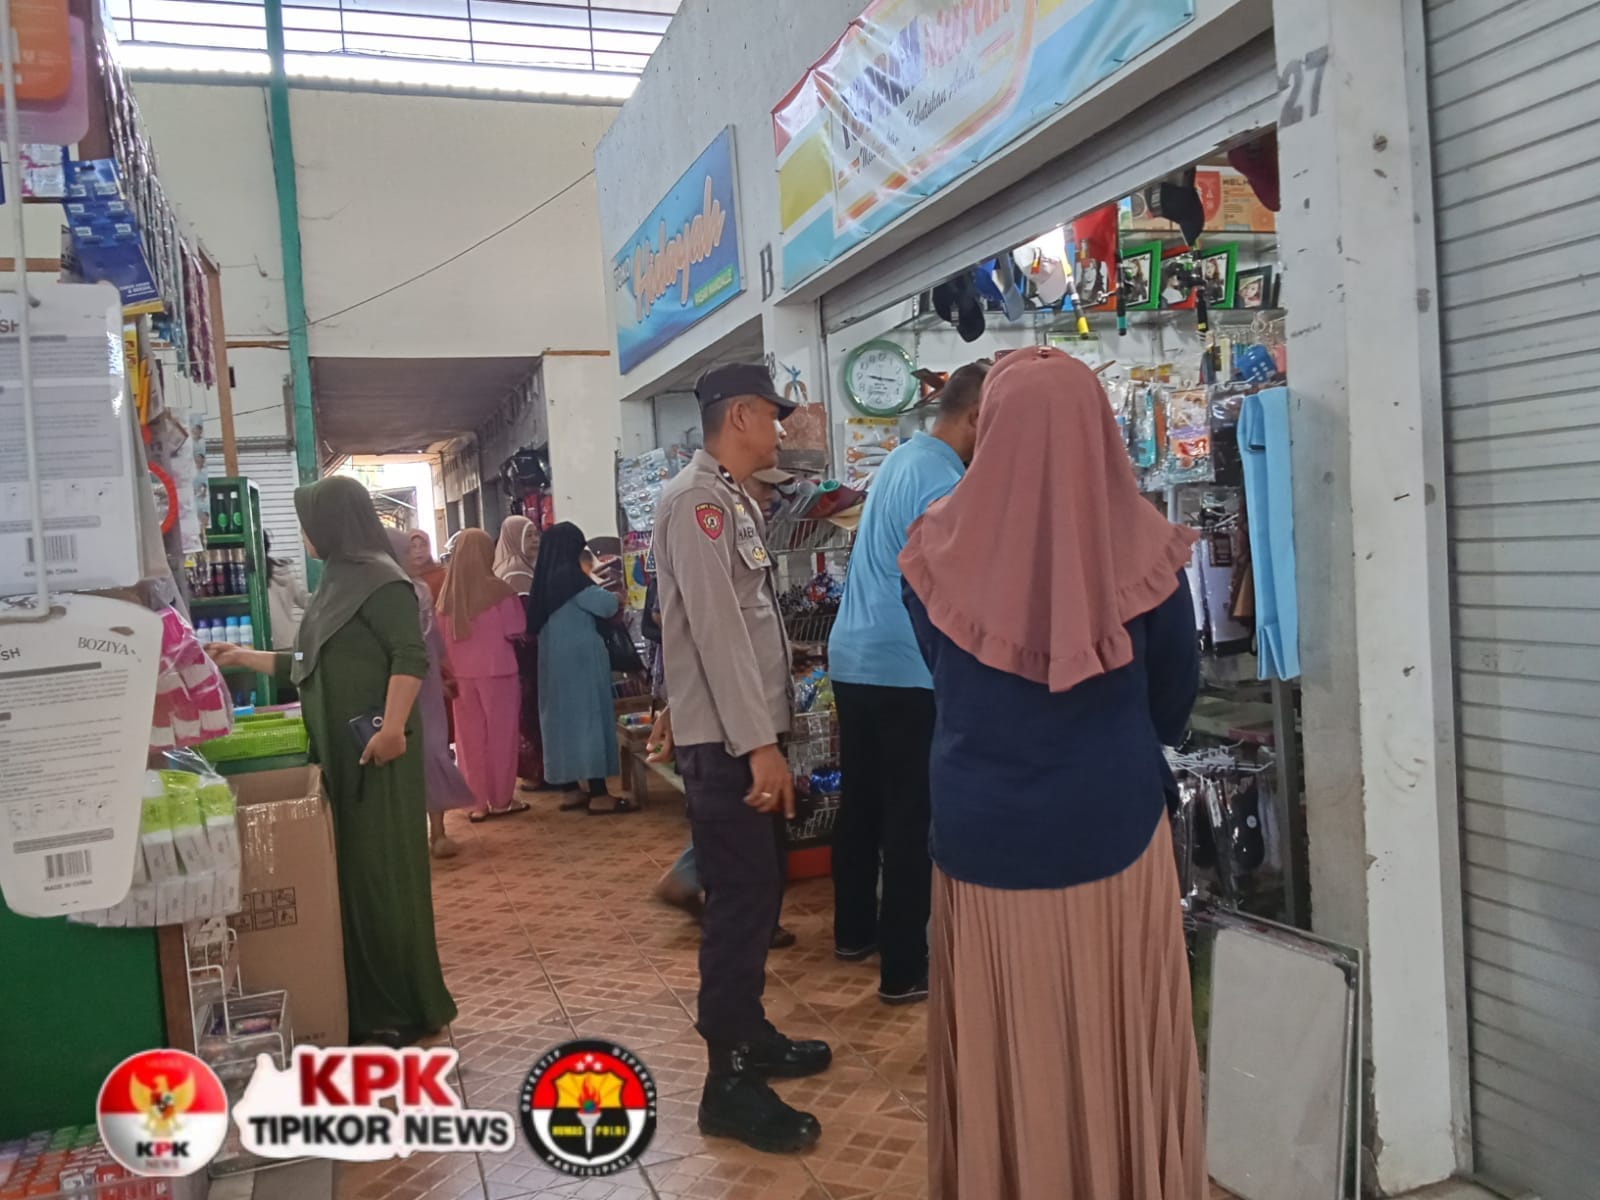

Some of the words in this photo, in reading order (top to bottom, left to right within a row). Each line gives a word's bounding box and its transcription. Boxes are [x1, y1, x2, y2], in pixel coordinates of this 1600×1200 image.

[1278, 46, 1328, 128] 27
[760, 242, 774, 302] B
[78, 636, 129, 655] BOZIYA
